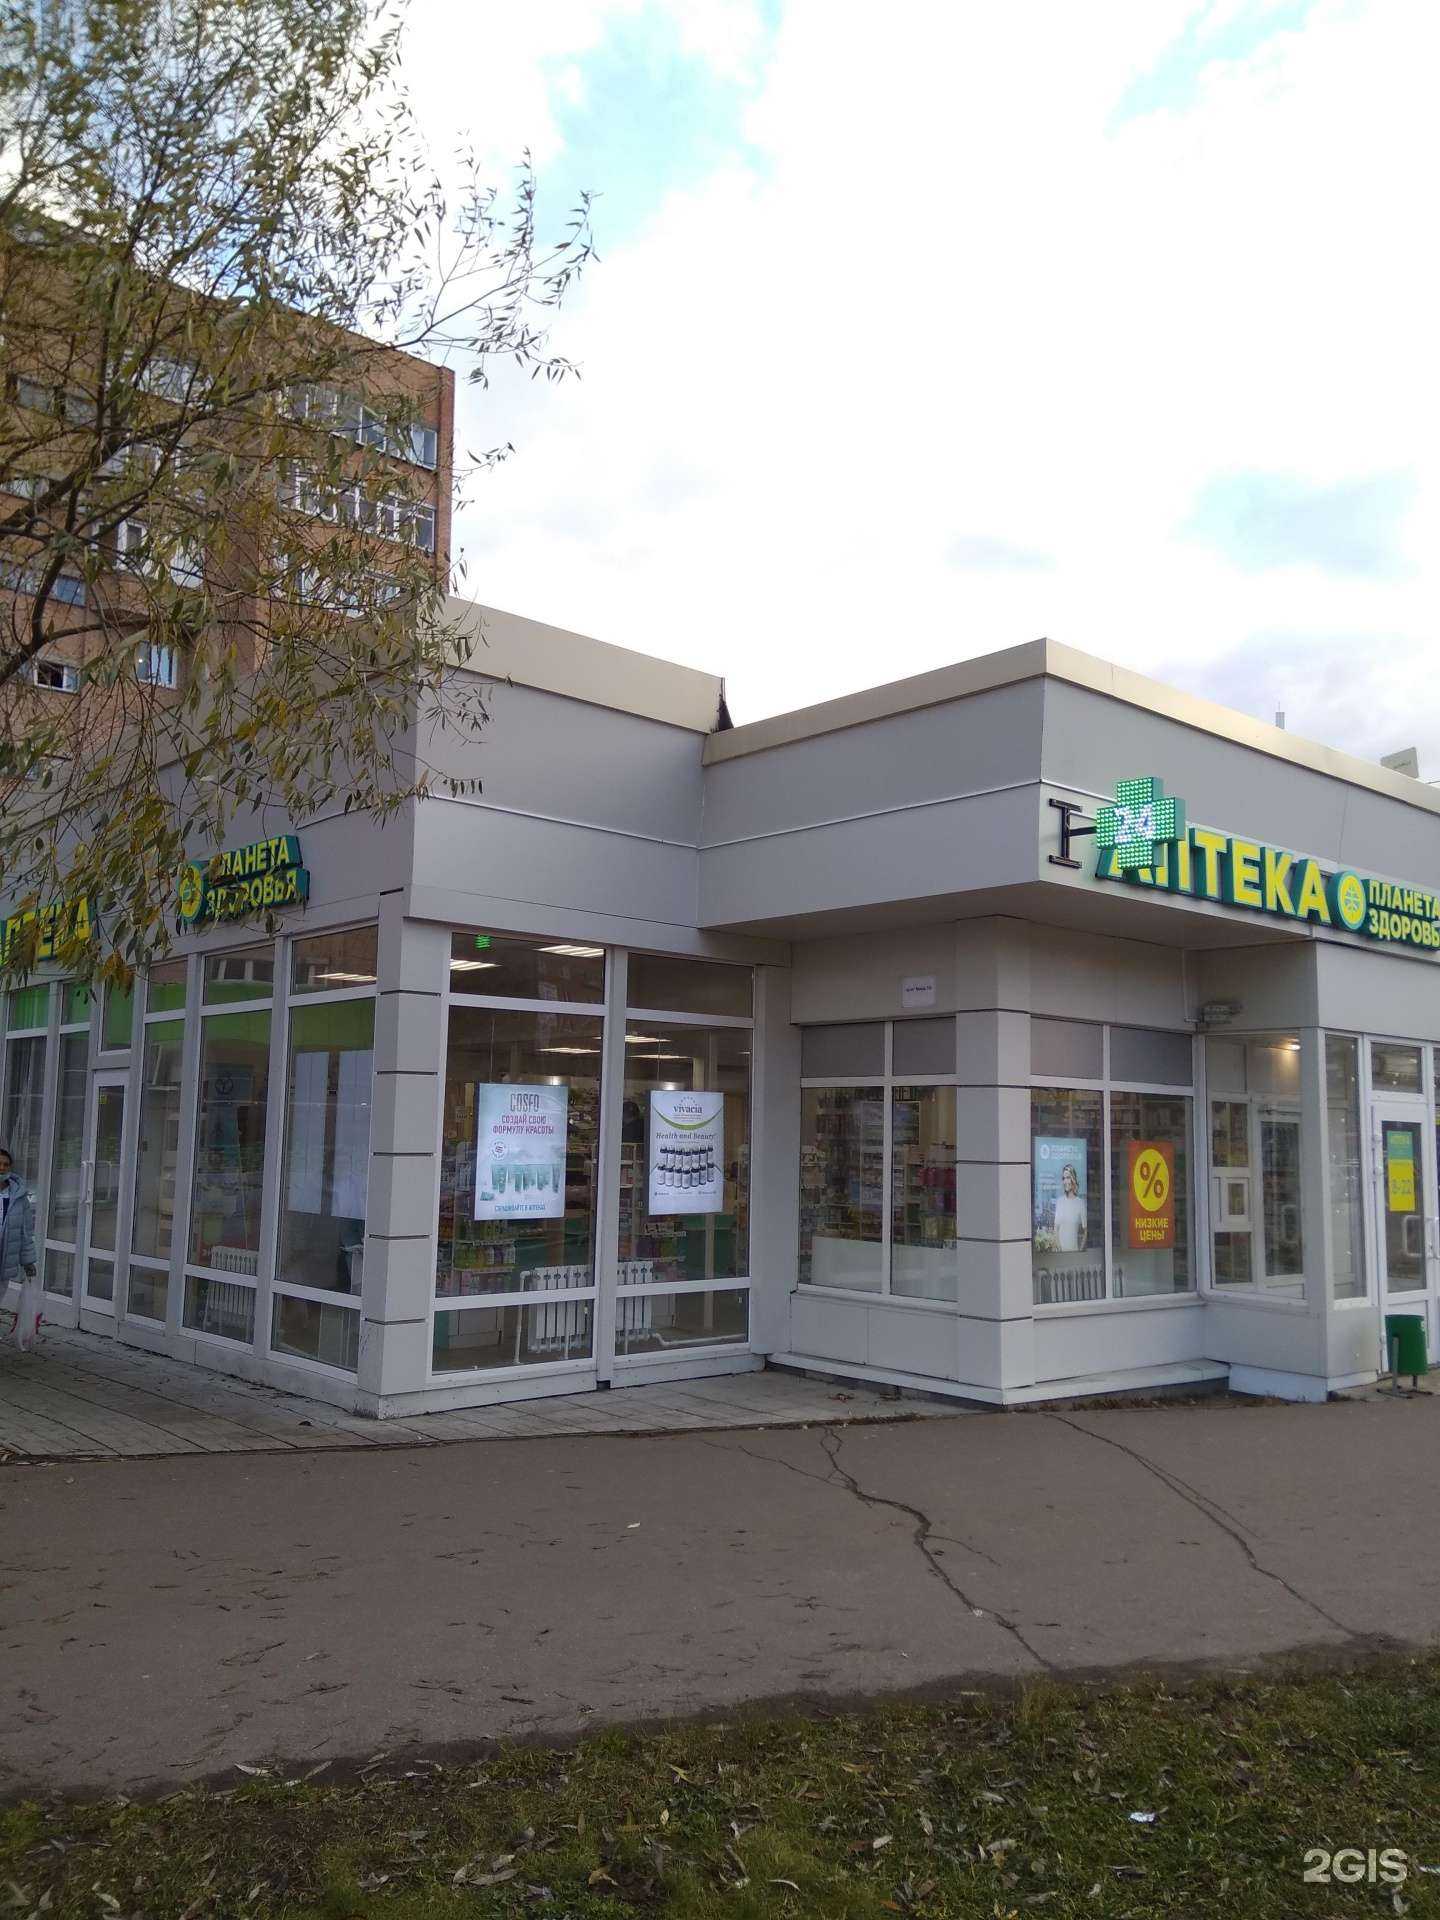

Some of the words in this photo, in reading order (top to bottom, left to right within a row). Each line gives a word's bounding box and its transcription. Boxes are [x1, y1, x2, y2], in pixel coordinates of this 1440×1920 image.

[209, 838, 289, 878] ЛАНЕТА
[1108, 821, 1331, 924] ПТЕКА
[673, 1103, 703, 1114] vivacia
[502, 1113, 527, 1124] СОЗДАЙ
[528, 1115, 547, 1125] СВОЮ
[492, 1125, 524, 1135] ФОРМУЛУ
[525, 1125, 554, 1136] КРАСОТЫ
[656, 1132, 678, 1140] Health
[679, 1132, 692, 1140] and
[693, 1132, 715, 1142] Beauty
[1135, 1218, 1169, 1229] НИЗКИЕ
[1140, 1230, 1165, 1243] ЦЕНЫ
